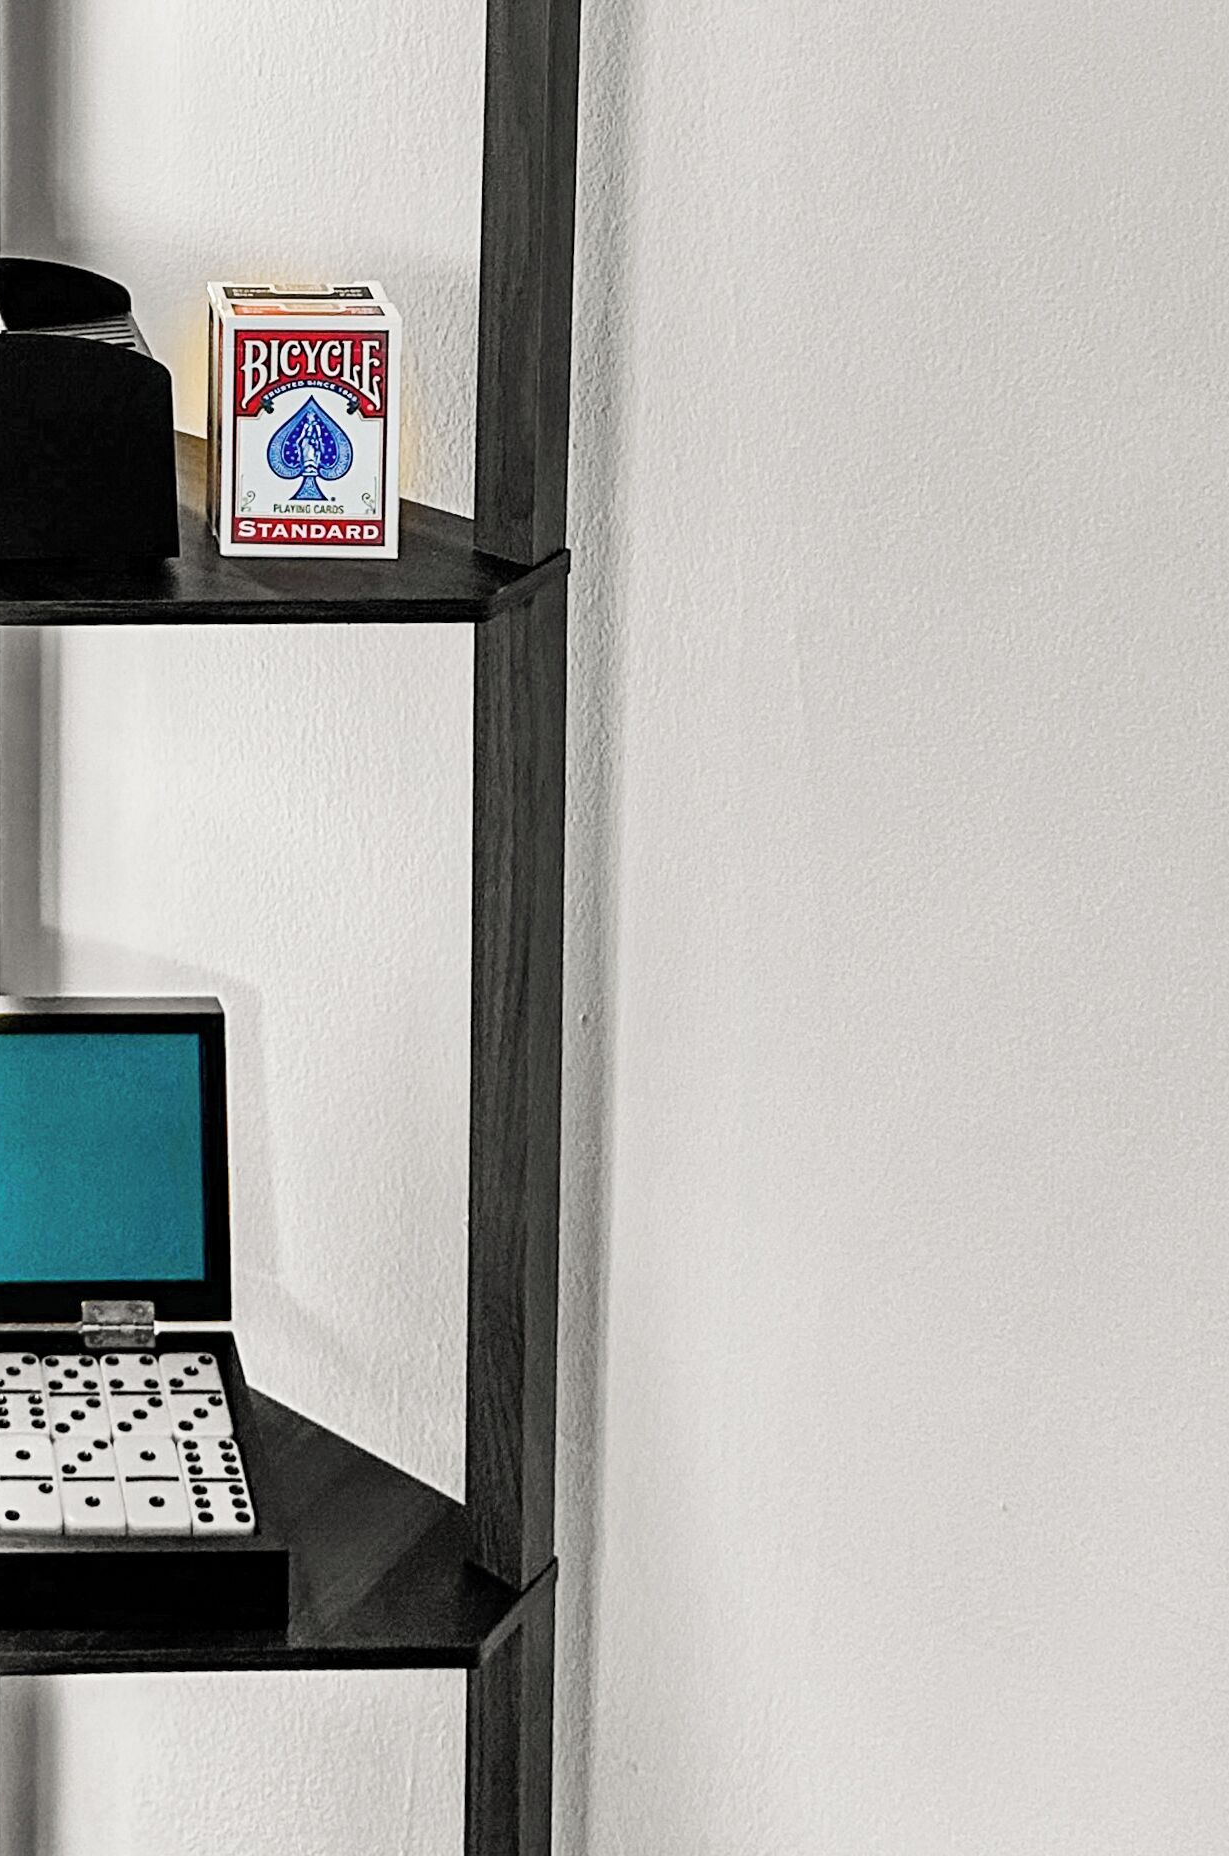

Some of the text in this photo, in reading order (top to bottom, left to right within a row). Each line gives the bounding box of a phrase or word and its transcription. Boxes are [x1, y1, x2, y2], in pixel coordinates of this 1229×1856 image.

[241, 340, 381, 410] BICYCLE
[273, 503, 345, 515] PLAYING CARDS
[238, 520, 379, 540] STANDARD
